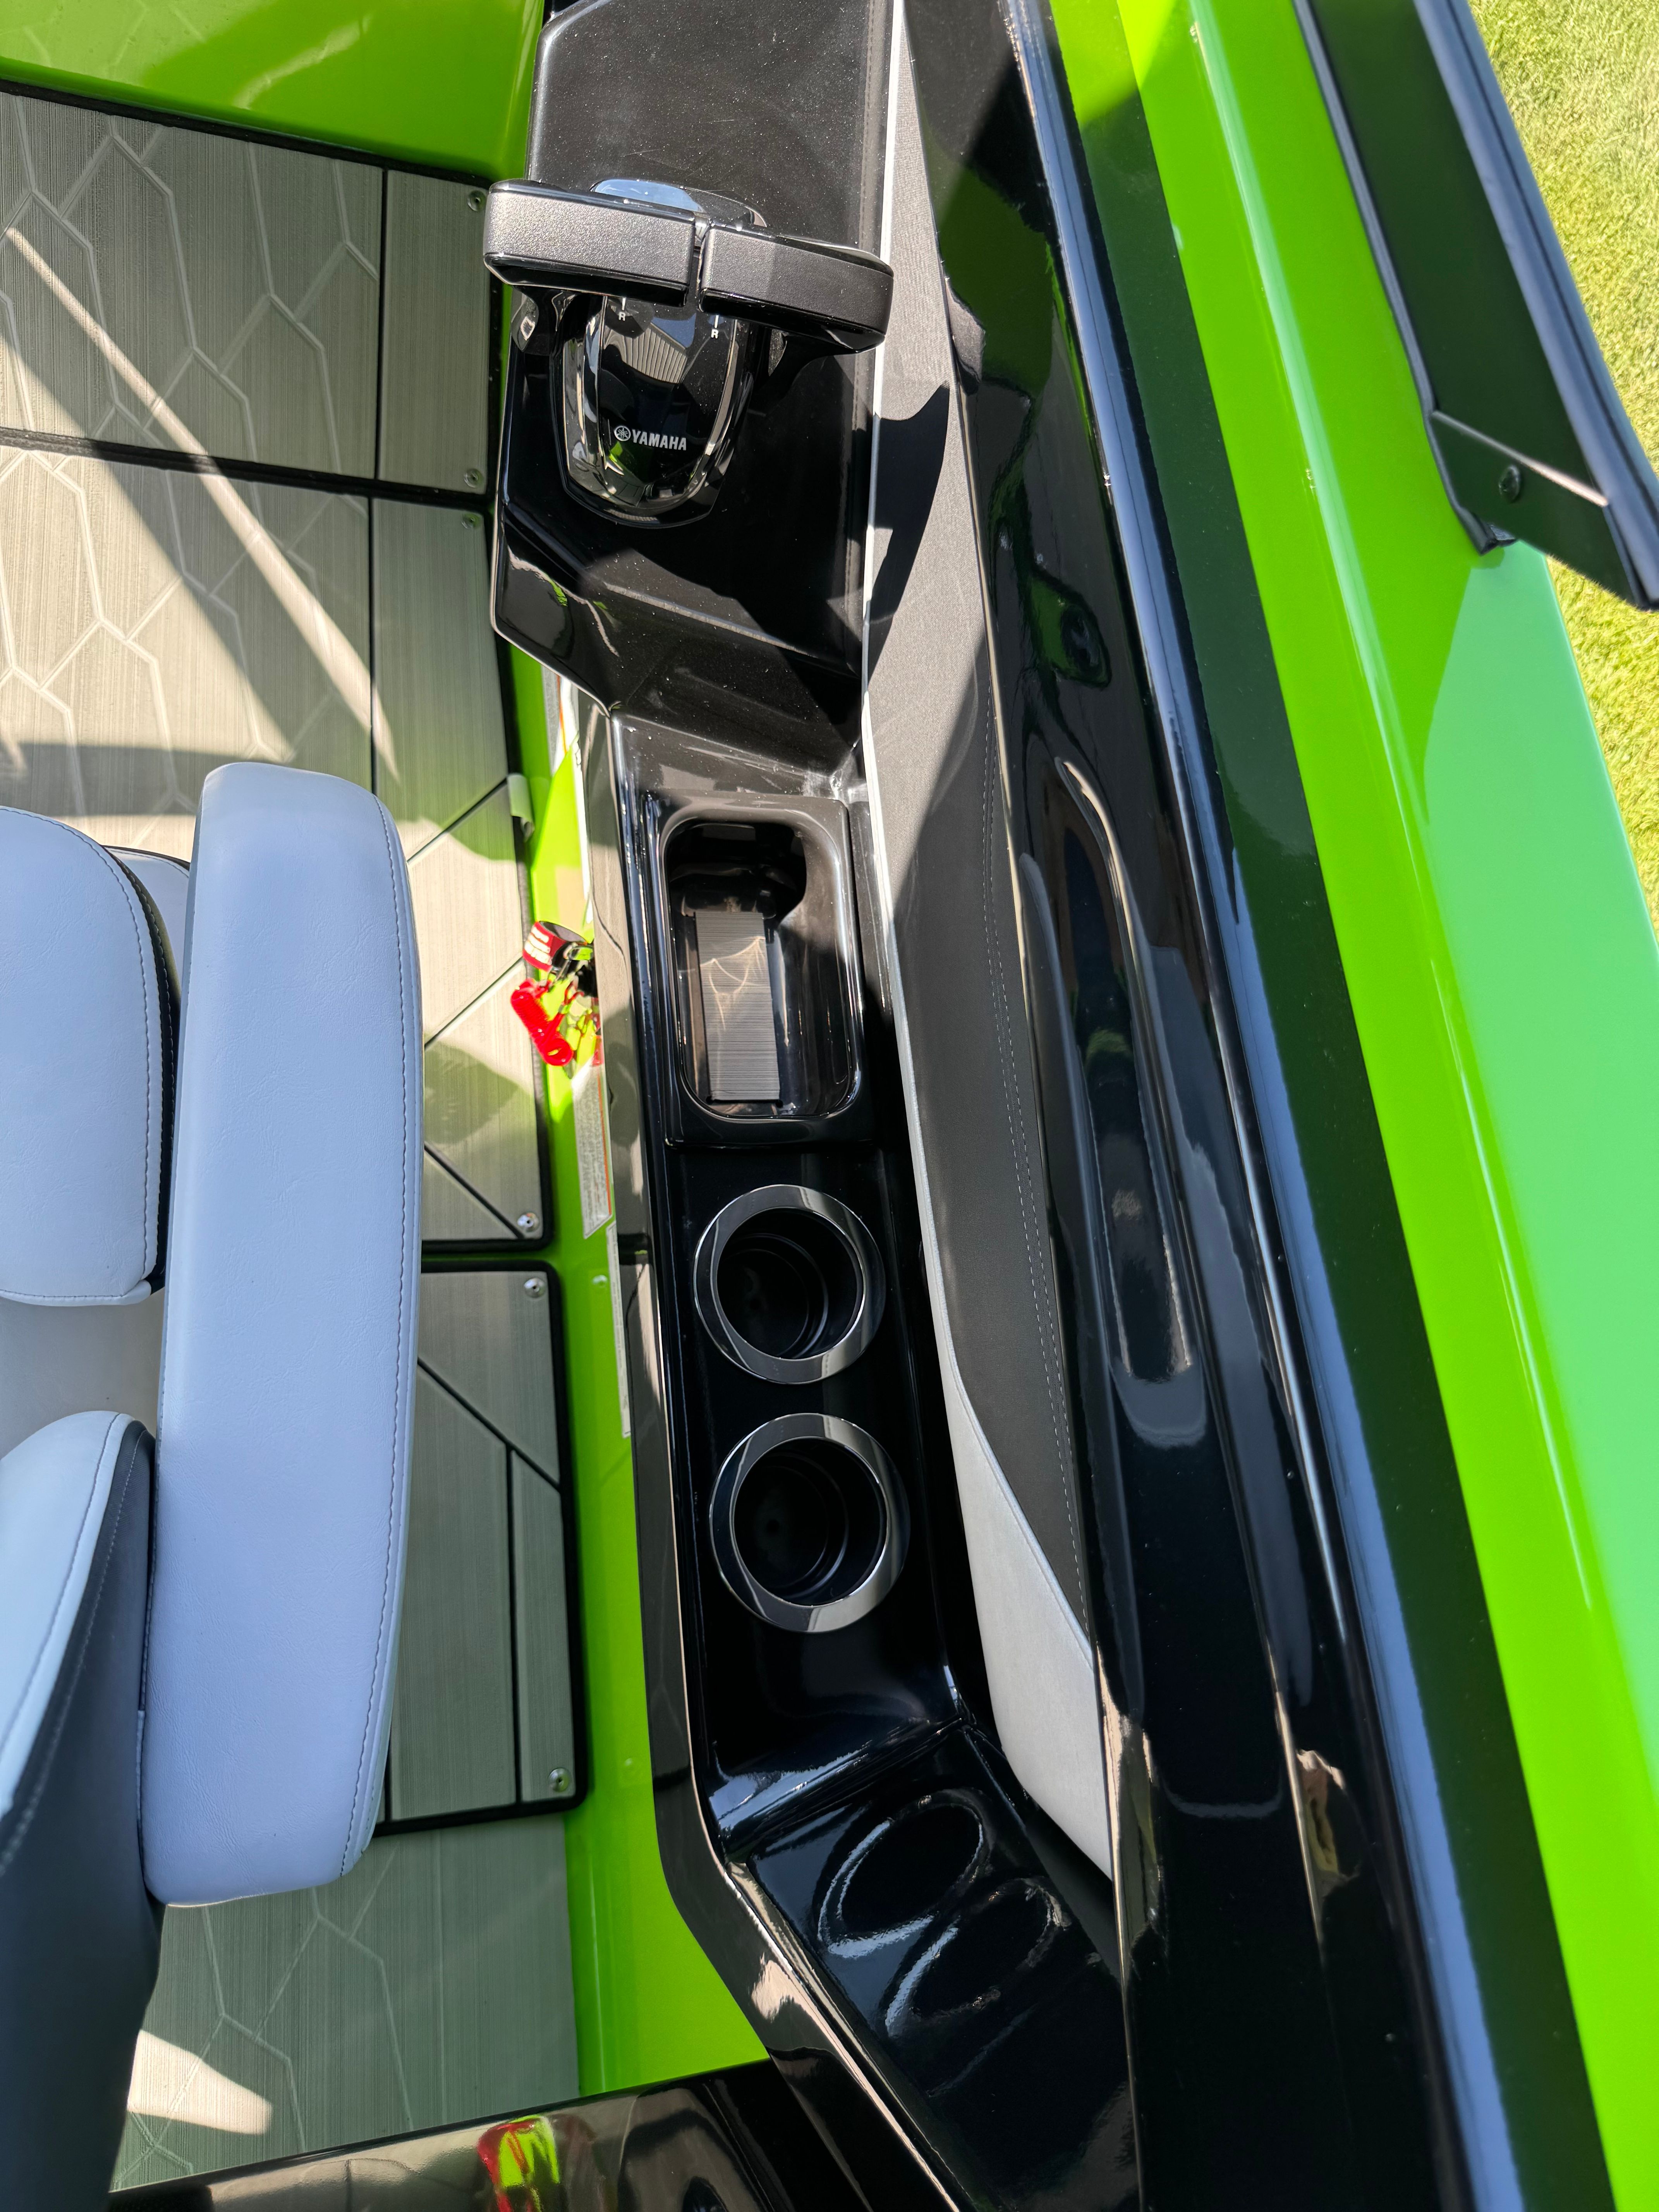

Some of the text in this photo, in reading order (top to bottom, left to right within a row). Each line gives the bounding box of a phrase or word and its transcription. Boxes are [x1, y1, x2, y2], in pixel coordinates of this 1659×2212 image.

[619, 312, 626, 321] R
[711, 329, 719, 339] R
[632, 429, 686, 451] YAMAHA
